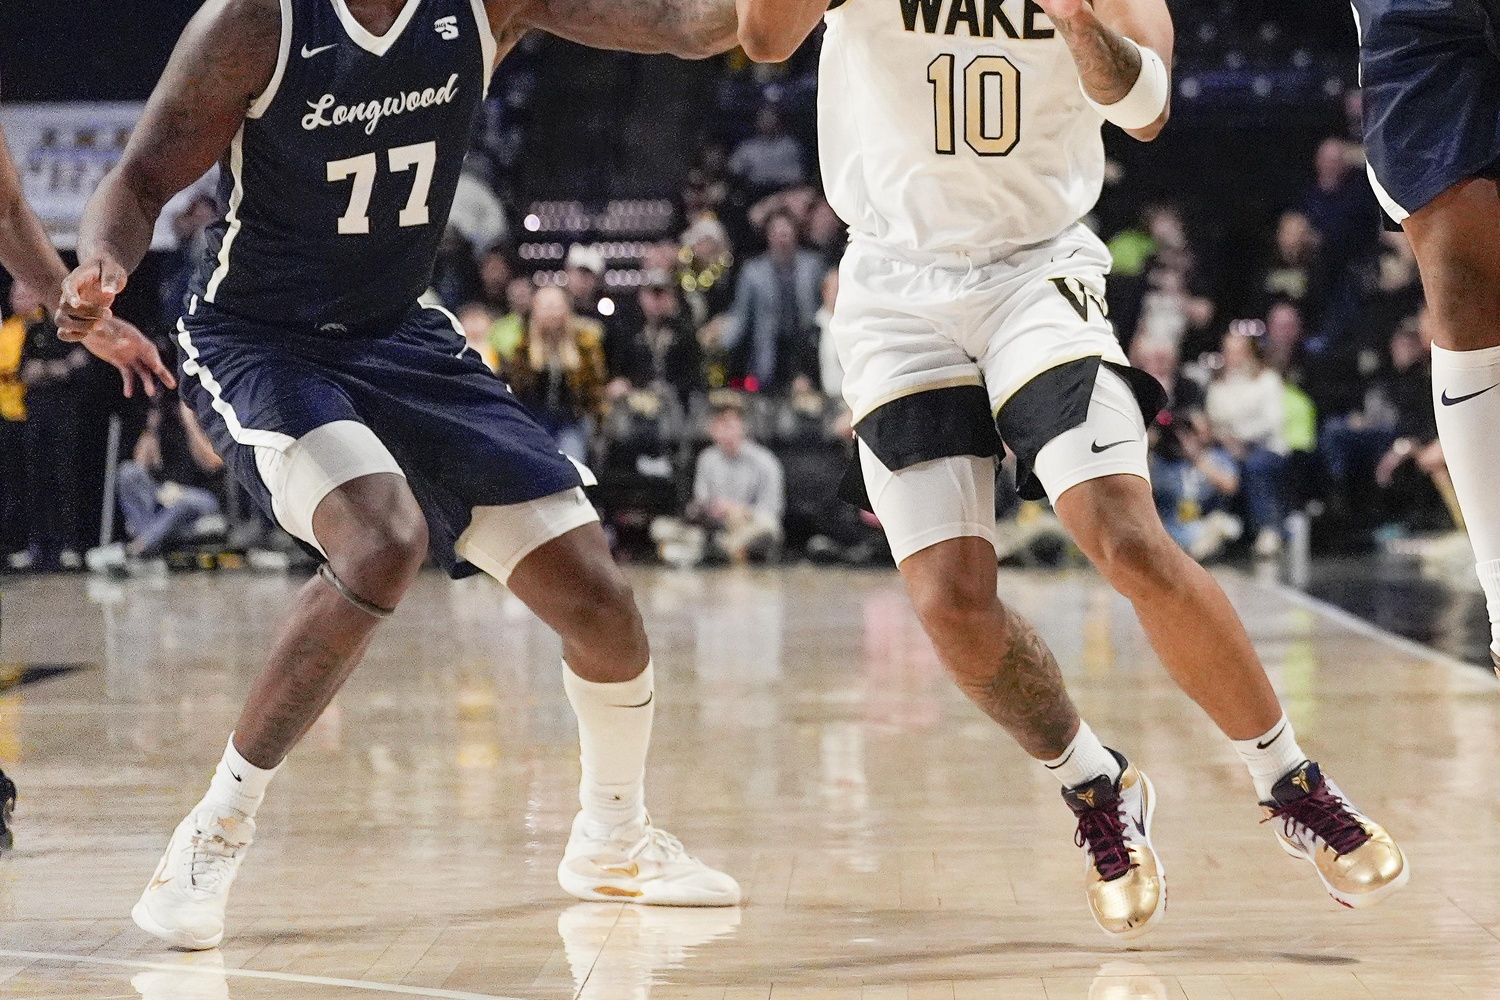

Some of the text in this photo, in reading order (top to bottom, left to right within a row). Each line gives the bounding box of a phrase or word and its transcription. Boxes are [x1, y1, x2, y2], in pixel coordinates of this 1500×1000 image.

[301, 73, 459, 134] Longwood
[926, 53, 1022, 158] 10
[326, 140, 437, 234] 77
